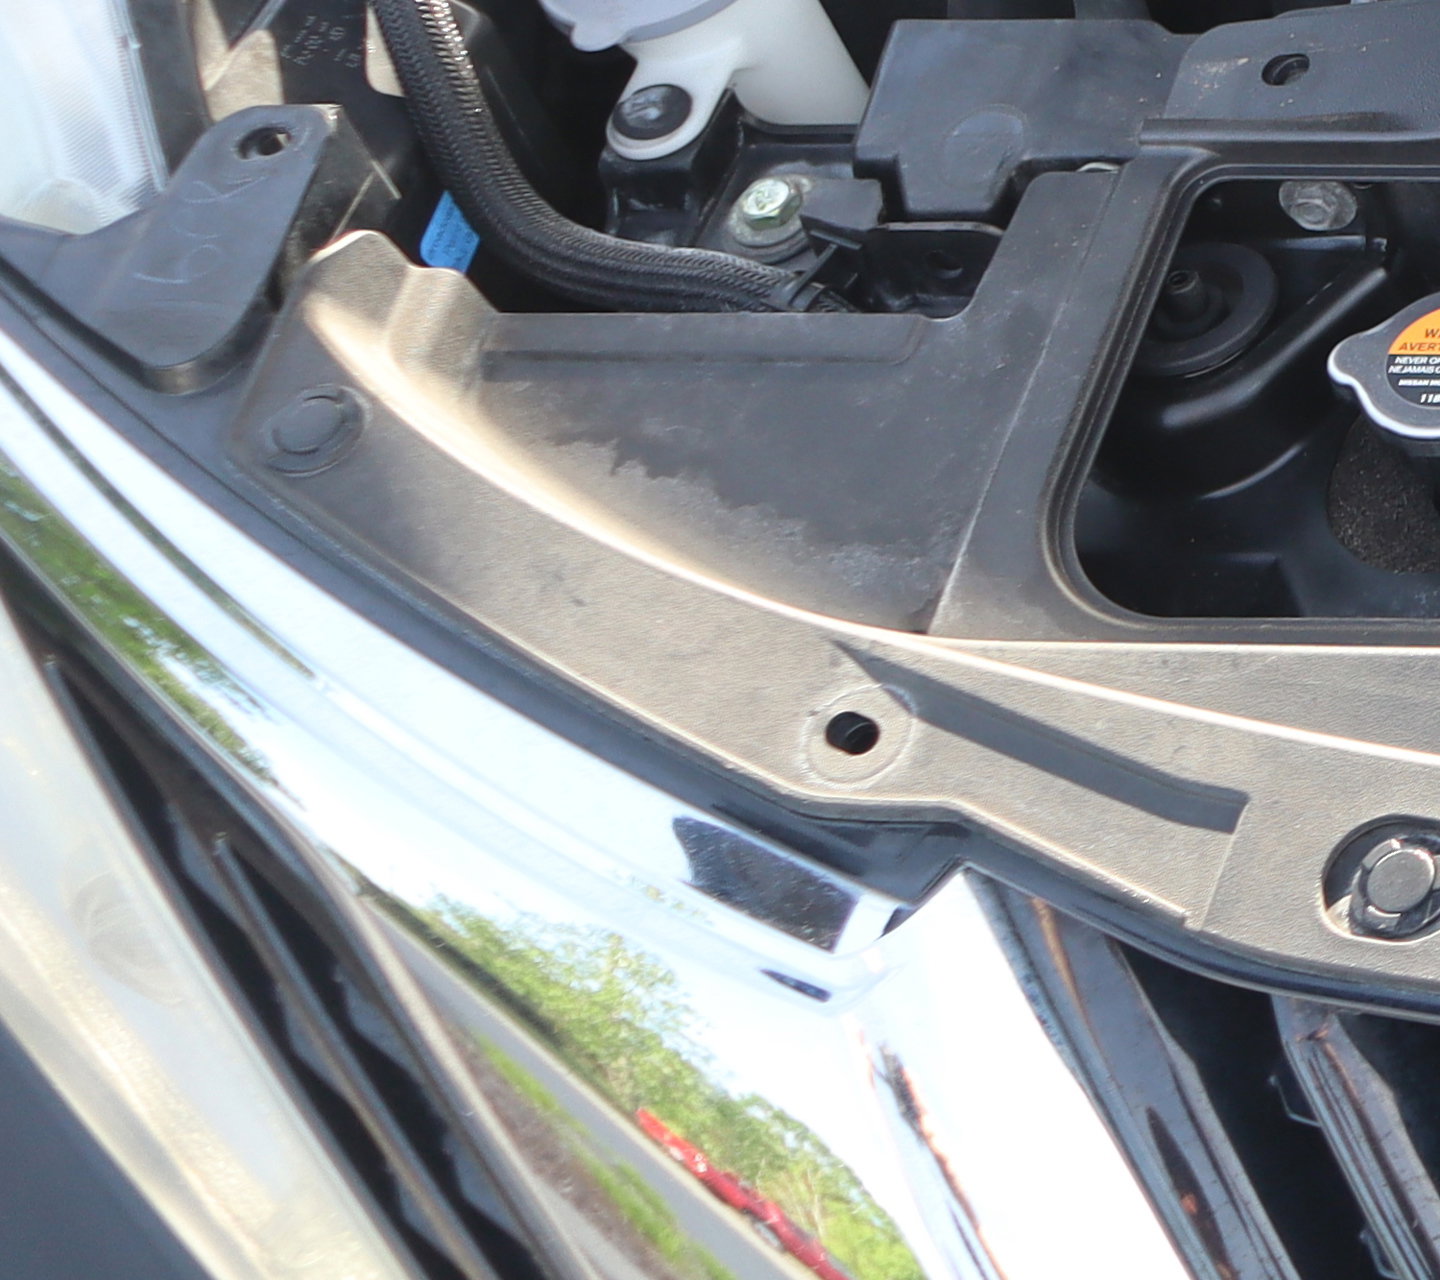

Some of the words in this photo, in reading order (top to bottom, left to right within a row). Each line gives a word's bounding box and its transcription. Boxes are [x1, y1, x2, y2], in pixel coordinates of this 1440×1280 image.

[1394, 356, 1428, 365] NEVER
[1388, 366, 1403, 374] NE
[1401, 366, 1435, 374] JAMAIS
[1398, 379, 1429, 387] NISSAN
